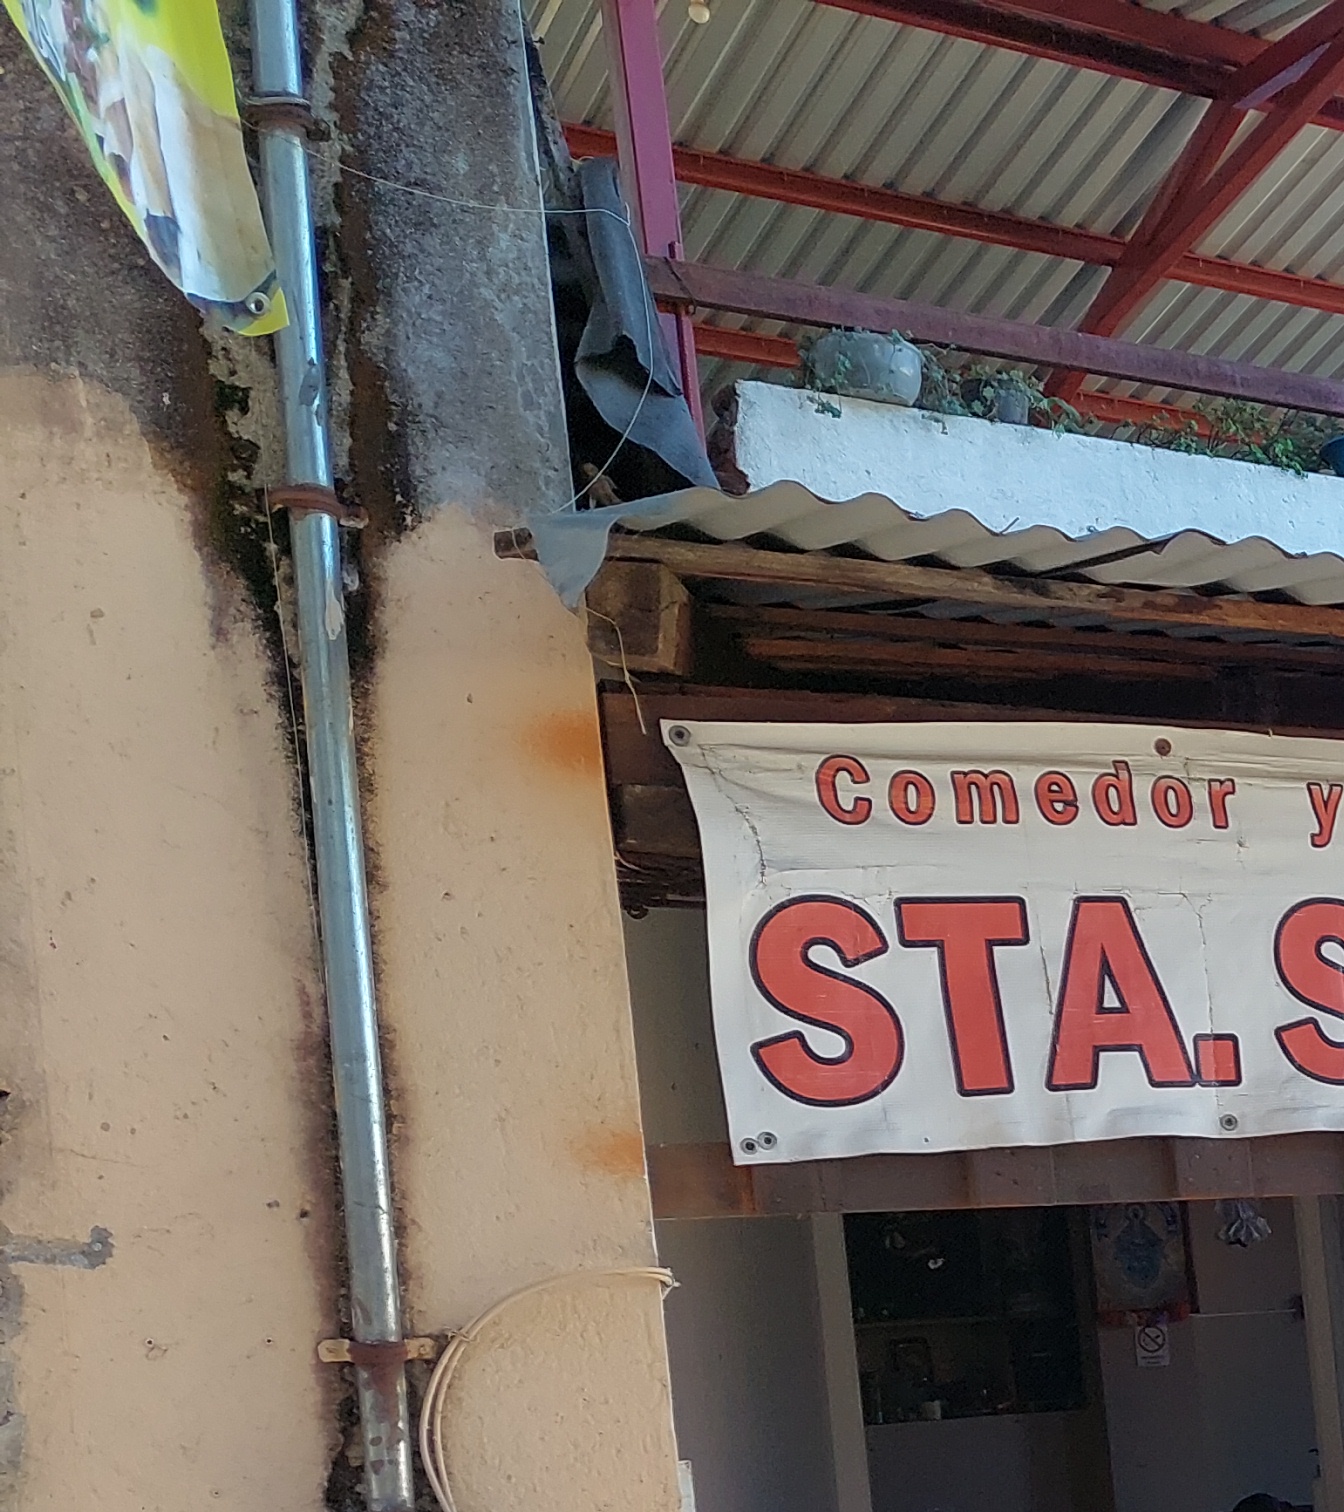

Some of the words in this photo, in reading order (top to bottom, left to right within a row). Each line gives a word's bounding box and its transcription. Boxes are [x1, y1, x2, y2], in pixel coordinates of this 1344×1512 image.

[814, 753, 1237, 831] Comedor
[1307, 779, 1344, 849] y
[750, 894, 1243, 1107] STA.
